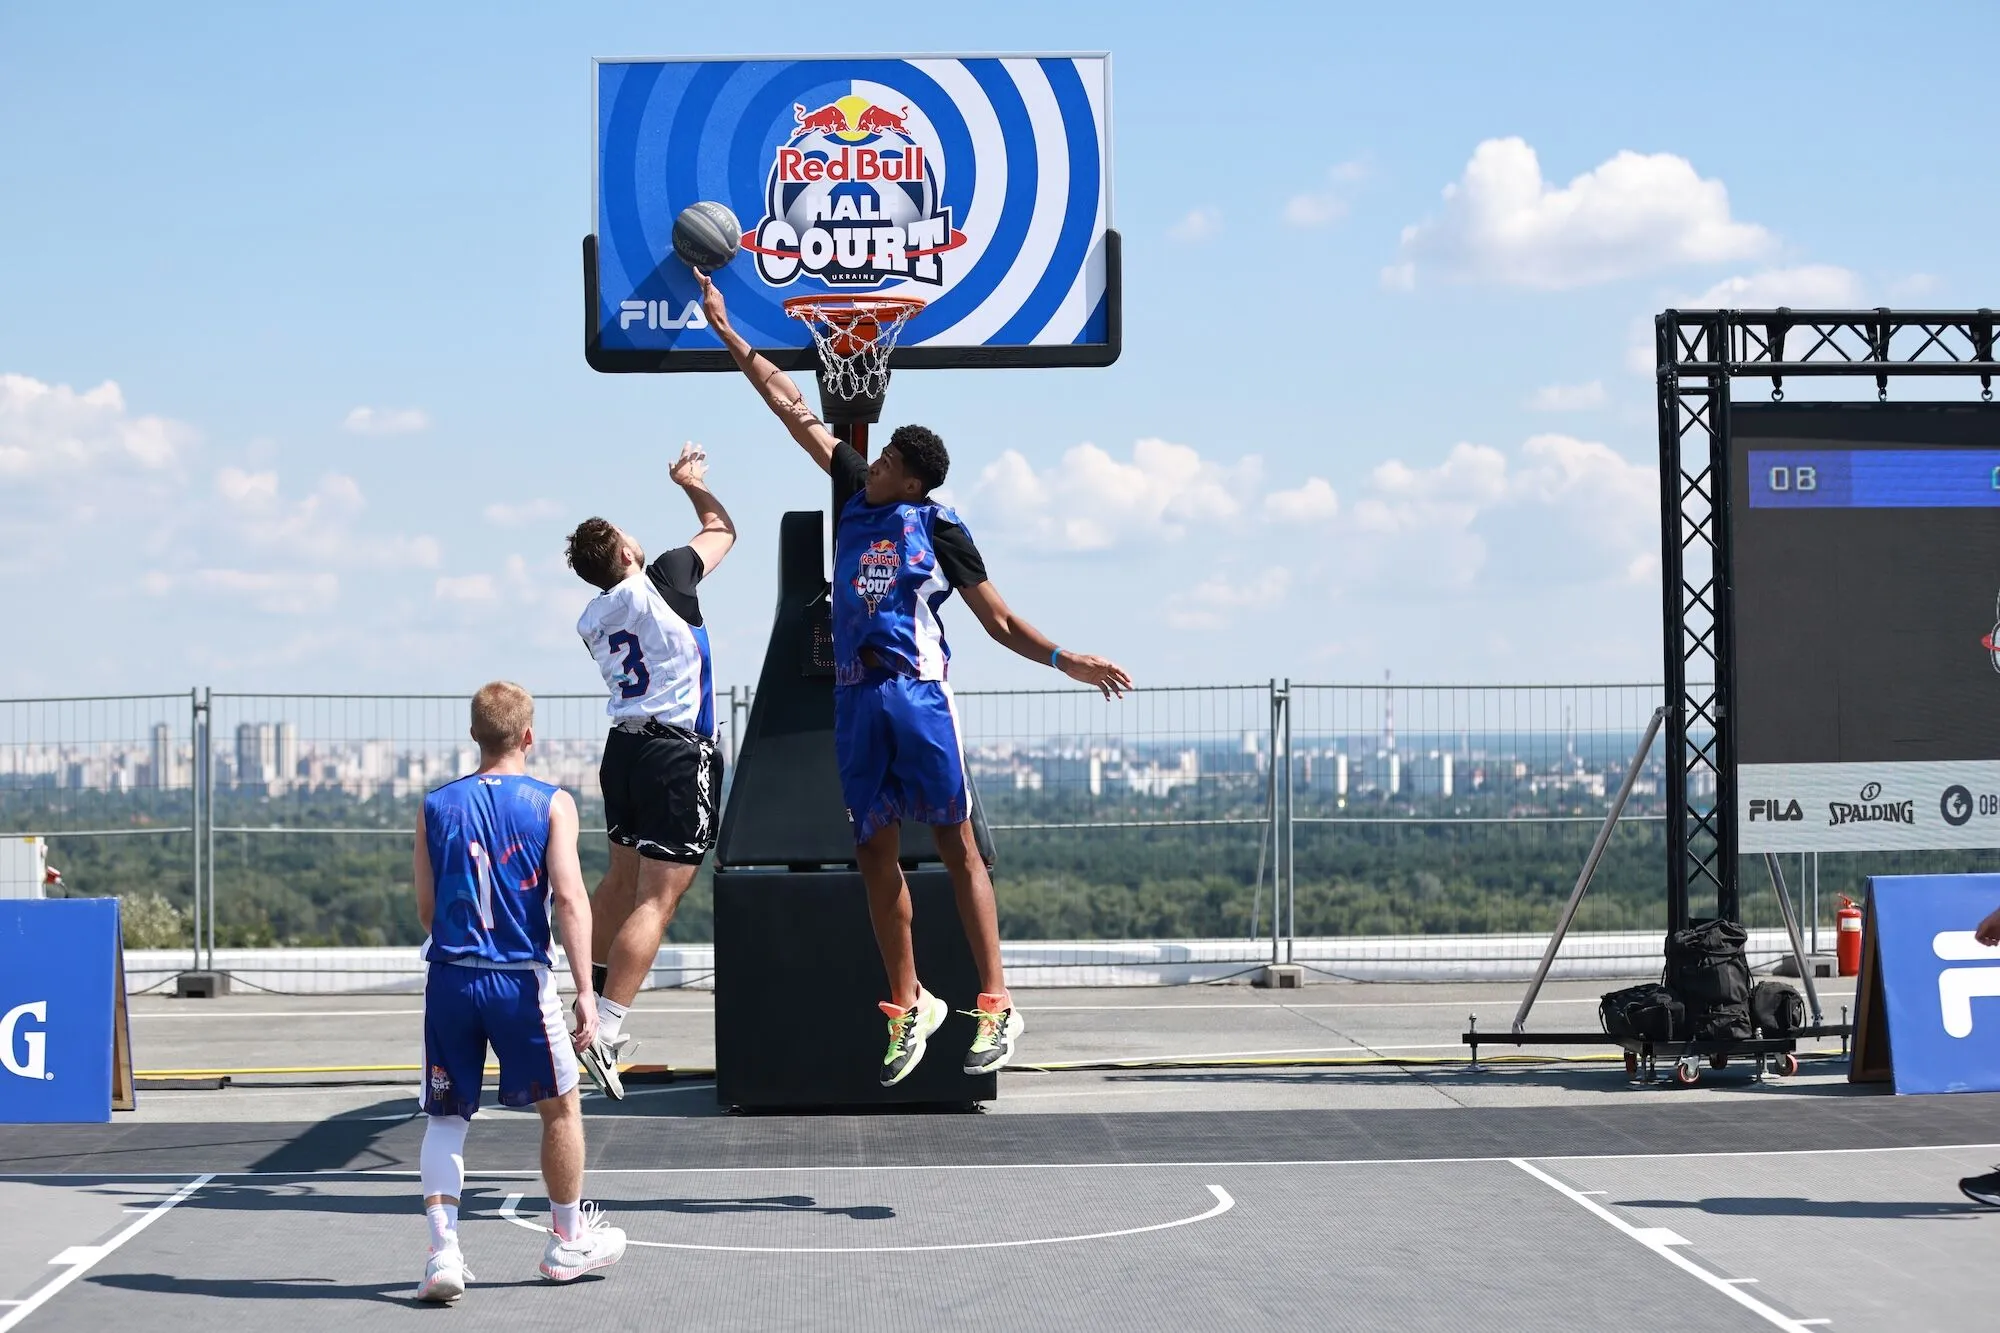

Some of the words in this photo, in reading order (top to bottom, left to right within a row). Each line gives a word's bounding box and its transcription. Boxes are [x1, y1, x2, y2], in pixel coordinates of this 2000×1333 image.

[779, 147, 849, 181] Red
[856, 147, 923, 181] Bull
[806, 194, 899, 221] HALF
[761, 216, 945, 280] COURT
[620, 300, 709, 330] FILA
[861, 553, 879, 565] Red
[880, 554, 899, 566] Bull
[868, 567, 893, 578] HALF
[608, 628, 650, 699] 3
[1749, 799, 1804, 822] FILA
[1829, 800, 1915, 826] SPALDING
[1979, 794, 2000, 815] OB
[470, 841, 495, 929] 1
